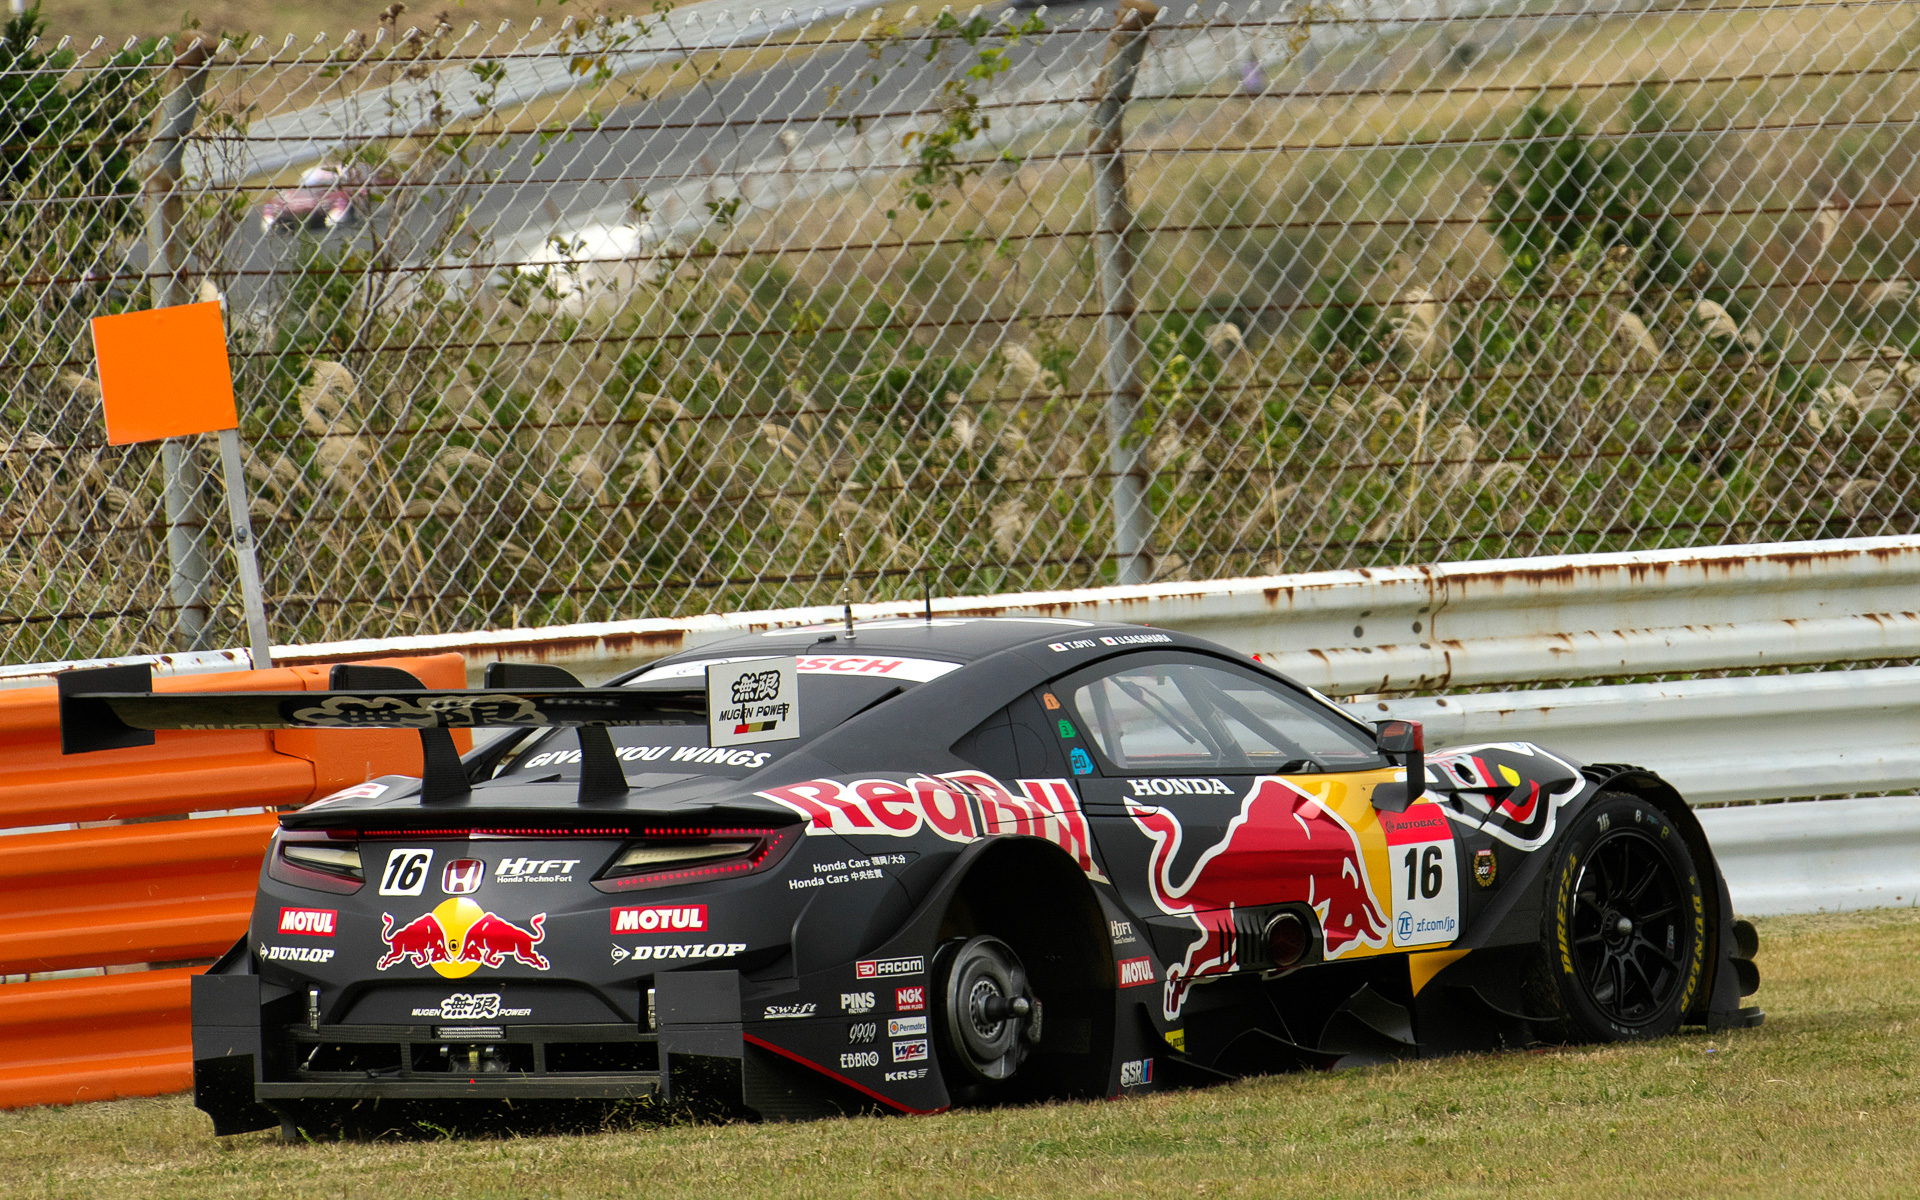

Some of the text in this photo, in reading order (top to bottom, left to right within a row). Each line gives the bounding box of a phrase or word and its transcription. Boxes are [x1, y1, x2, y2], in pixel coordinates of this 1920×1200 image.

[1064, 639, 1097, 650] T.OYU
[1115, 634, 1173, 645] U.SASAHARA
[797, 657, 904, 674] SCH
[732, 669, 781, 704] 無限
[719, 703, 790, 722] MUGEN POWER
[615, 746, 671, 762] YOU
[669, 746, 773, 769] WINGS
[1127, 778, 1235, 796] HONDA
[1396, 817, 1445, 831] AUTOBACS
[384, 853, 429, 891] 16
[494, 857, 581, 877] HTFT
[812, 860, 848, 874] Honda
[847, 858, 871, 869] Cars
[1404, 845, 1443, 901] 16
[496, 875, 523, 884] Honda
[788, 876, 825, 891] Honda
[825, 873, 850, 885] Cars
[280, 911, 334, 932] MOTUL
[615, 907, 704, 931] MOTUL
[1416, 915, 1456, 933] zf.com/jp
[267, 947, 335, 963] DUNLOP
[631, 943, 747, 961] DUNLOP
[1681, 894, 1704, 1013] DUNLOP
[877, 959, 922, 975] FACOM
[1121, 959, 1154, 985] MOTUL
[840, 991, 876, 1010] PINS
[897, 987, 923, 1005] NGK
[411, 993, 532, 1019] MUGEN 無限 POWER
[899, 1023, 926, 1032] Permatex
[840, 1051, 880, 1069] EBBRO
[885, 1069, 918, 1082] KRS
[1120, 1060, 1143, 1086] SSR
